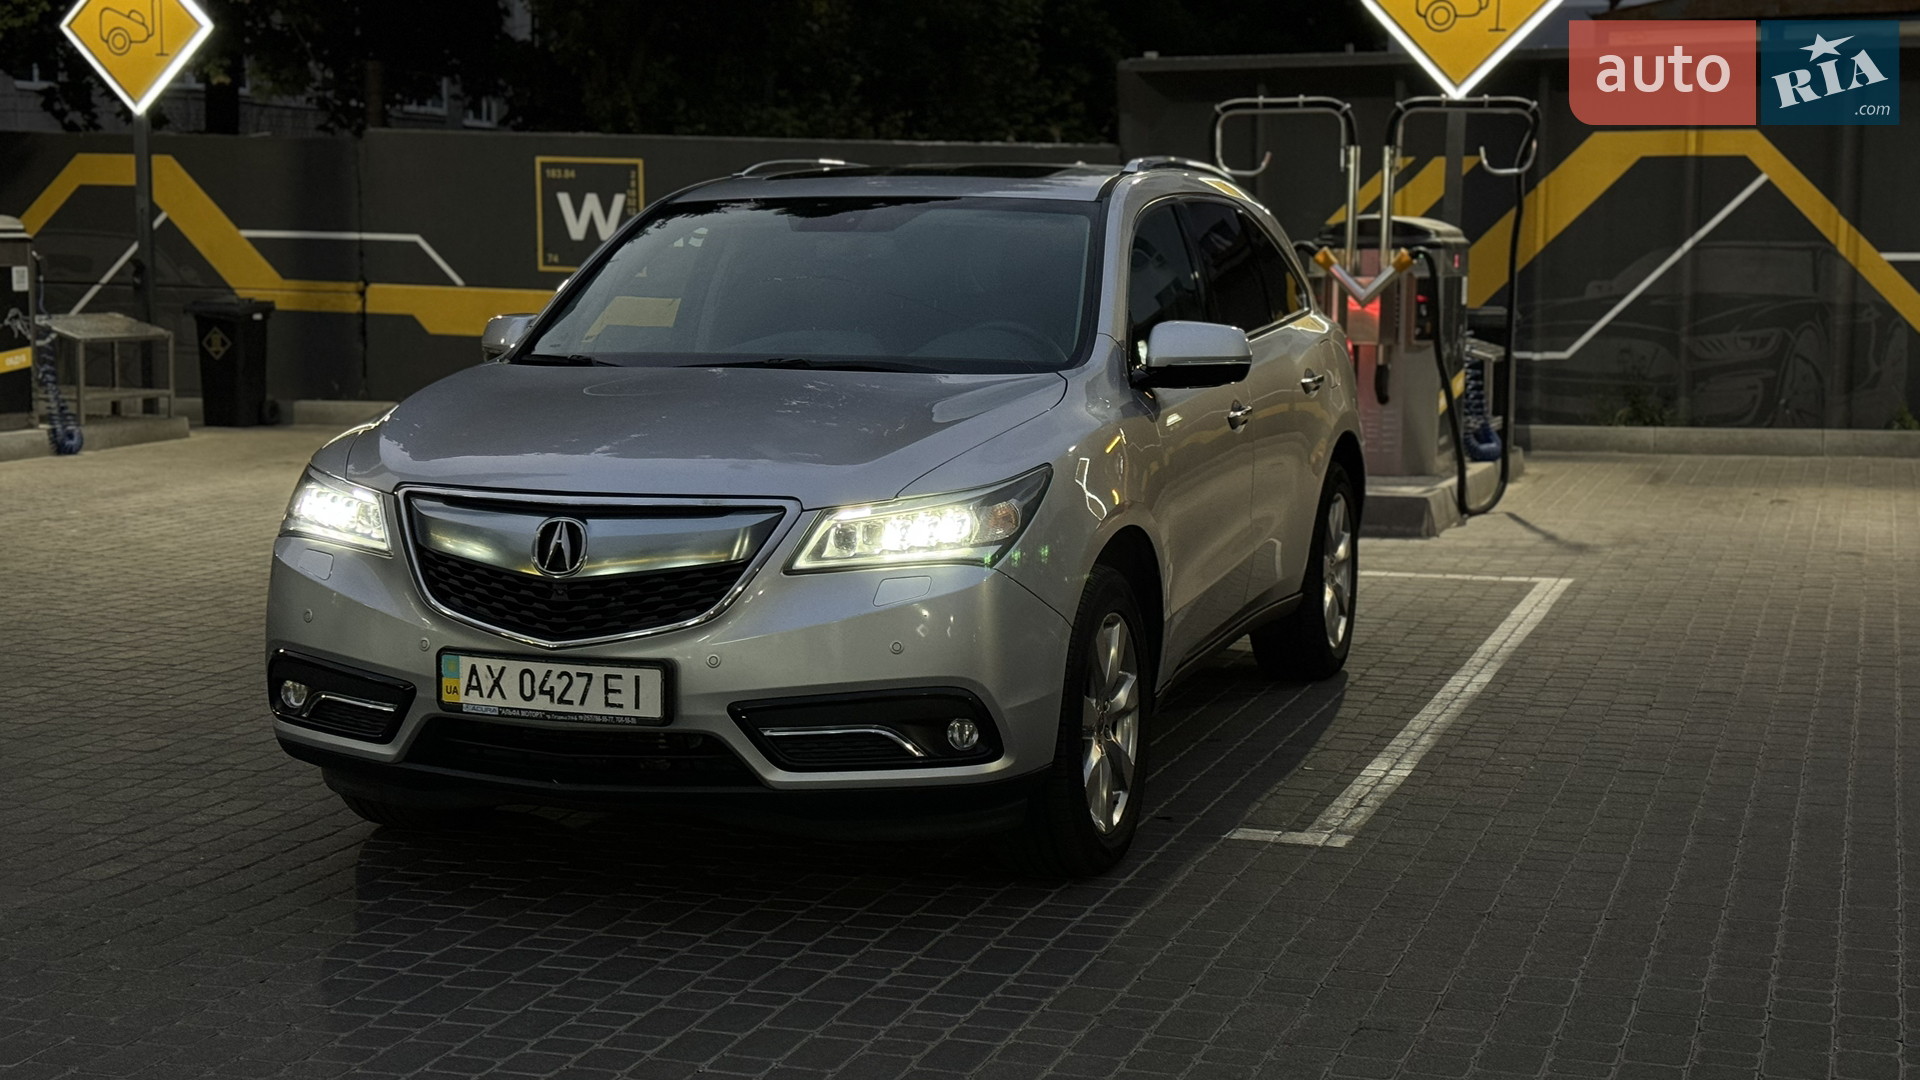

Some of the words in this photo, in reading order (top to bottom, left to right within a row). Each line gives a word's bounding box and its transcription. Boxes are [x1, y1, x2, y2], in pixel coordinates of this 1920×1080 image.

[556, 192, 626, 241] W
[445, 684, 459, 695] UA
[464, 663, 507, 700] AX
[519, 668, 593, 706] 0427
[604, 674, 640, 710] EI
